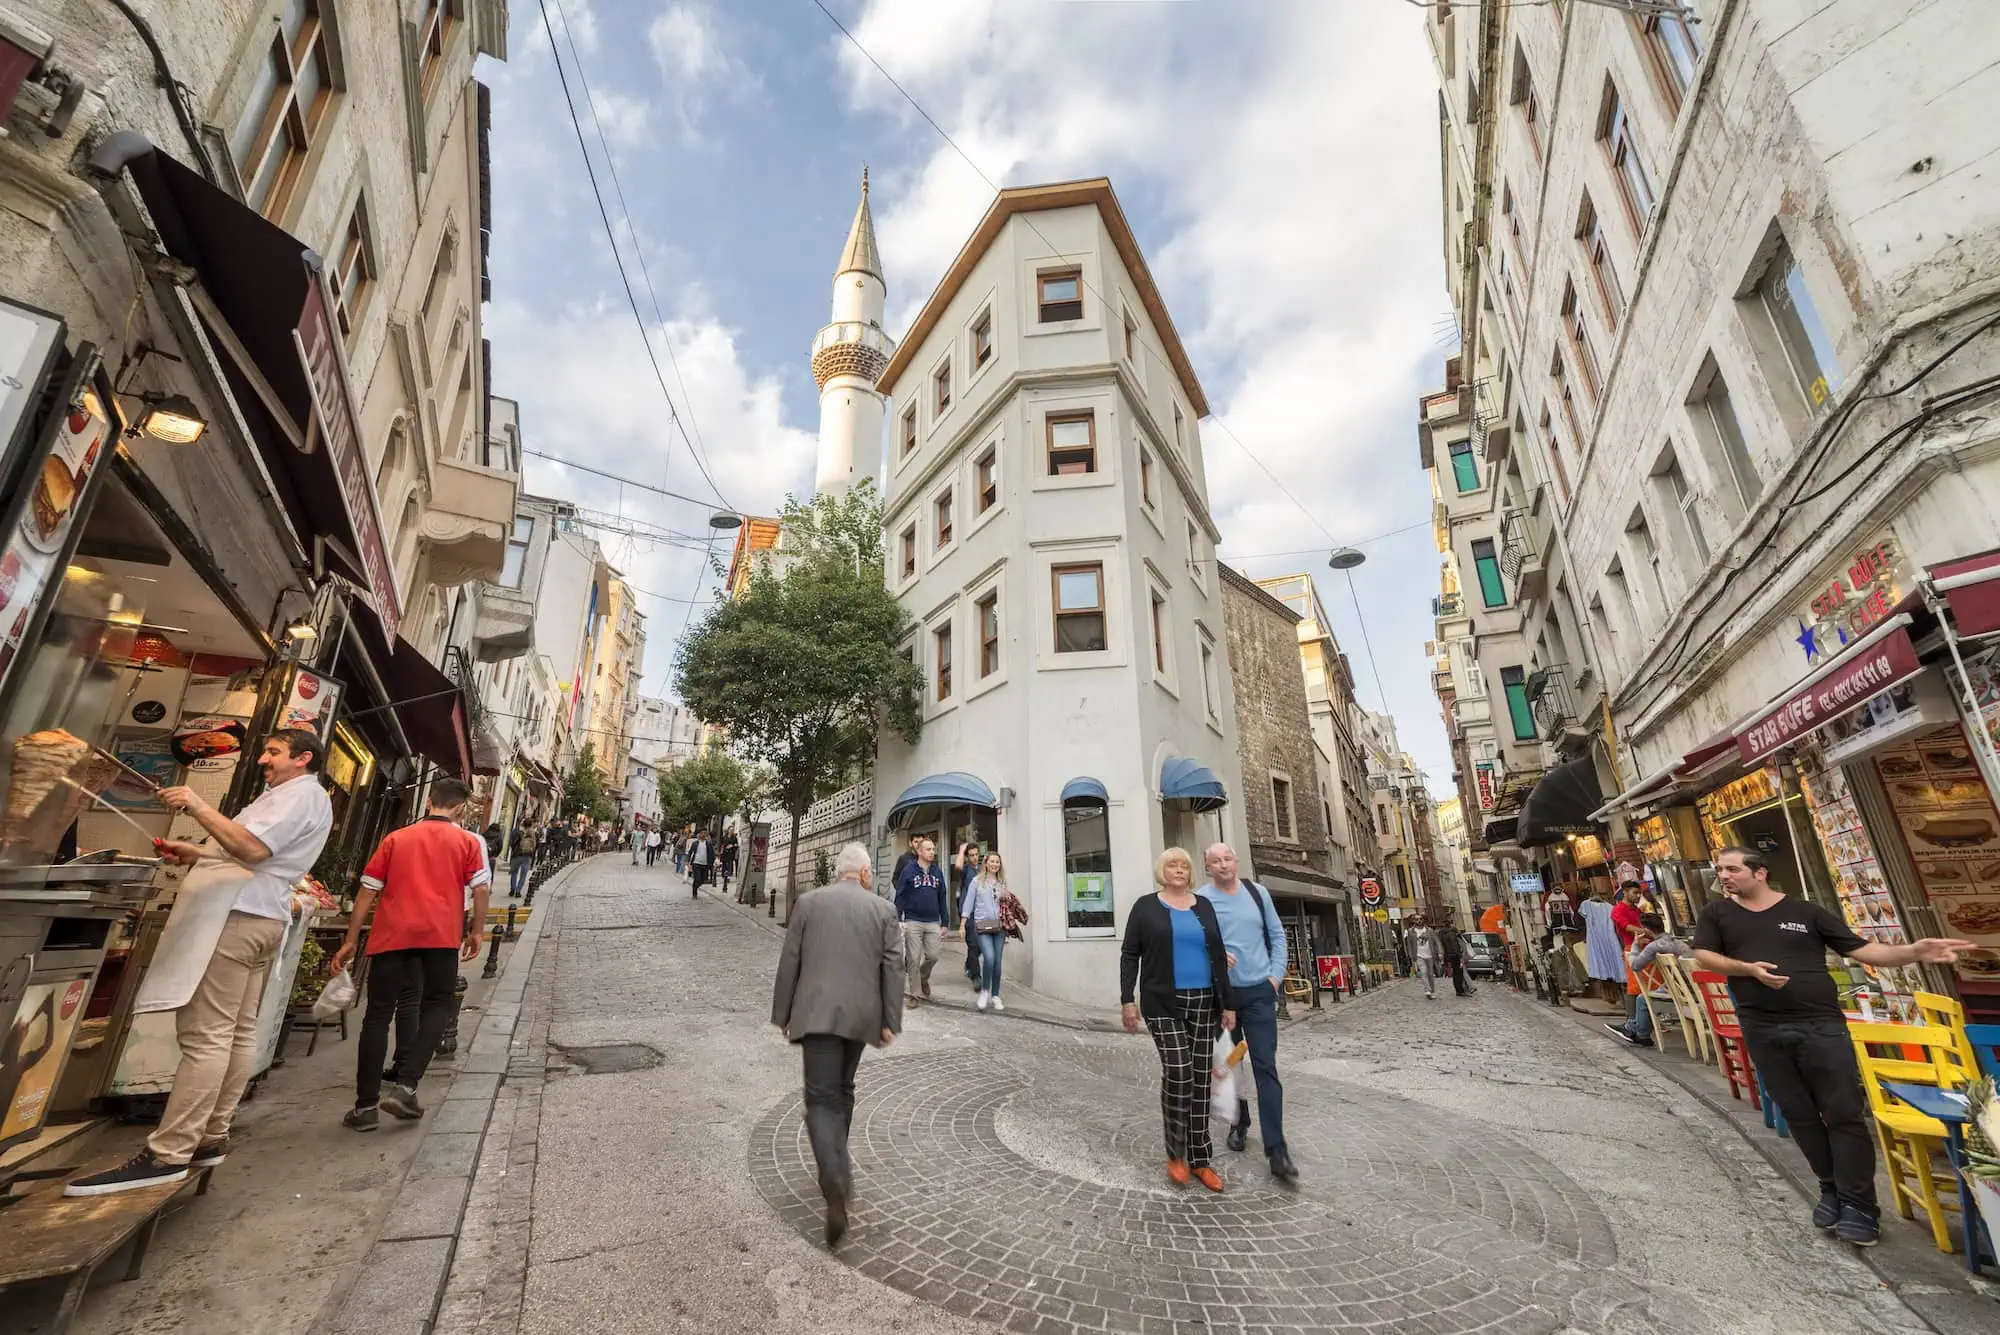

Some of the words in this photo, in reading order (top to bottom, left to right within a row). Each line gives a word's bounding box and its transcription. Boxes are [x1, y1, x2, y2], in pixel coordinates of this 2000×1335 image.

[1810, 580, 1846, 622] STAR
[1848, 541, 1892, 593] BÜFE
[1748, 719, 1779, 753] STAR
[1779, 694, 1814, 733] BÜFE
[1477, 769, 1493, 809] TATTOO
